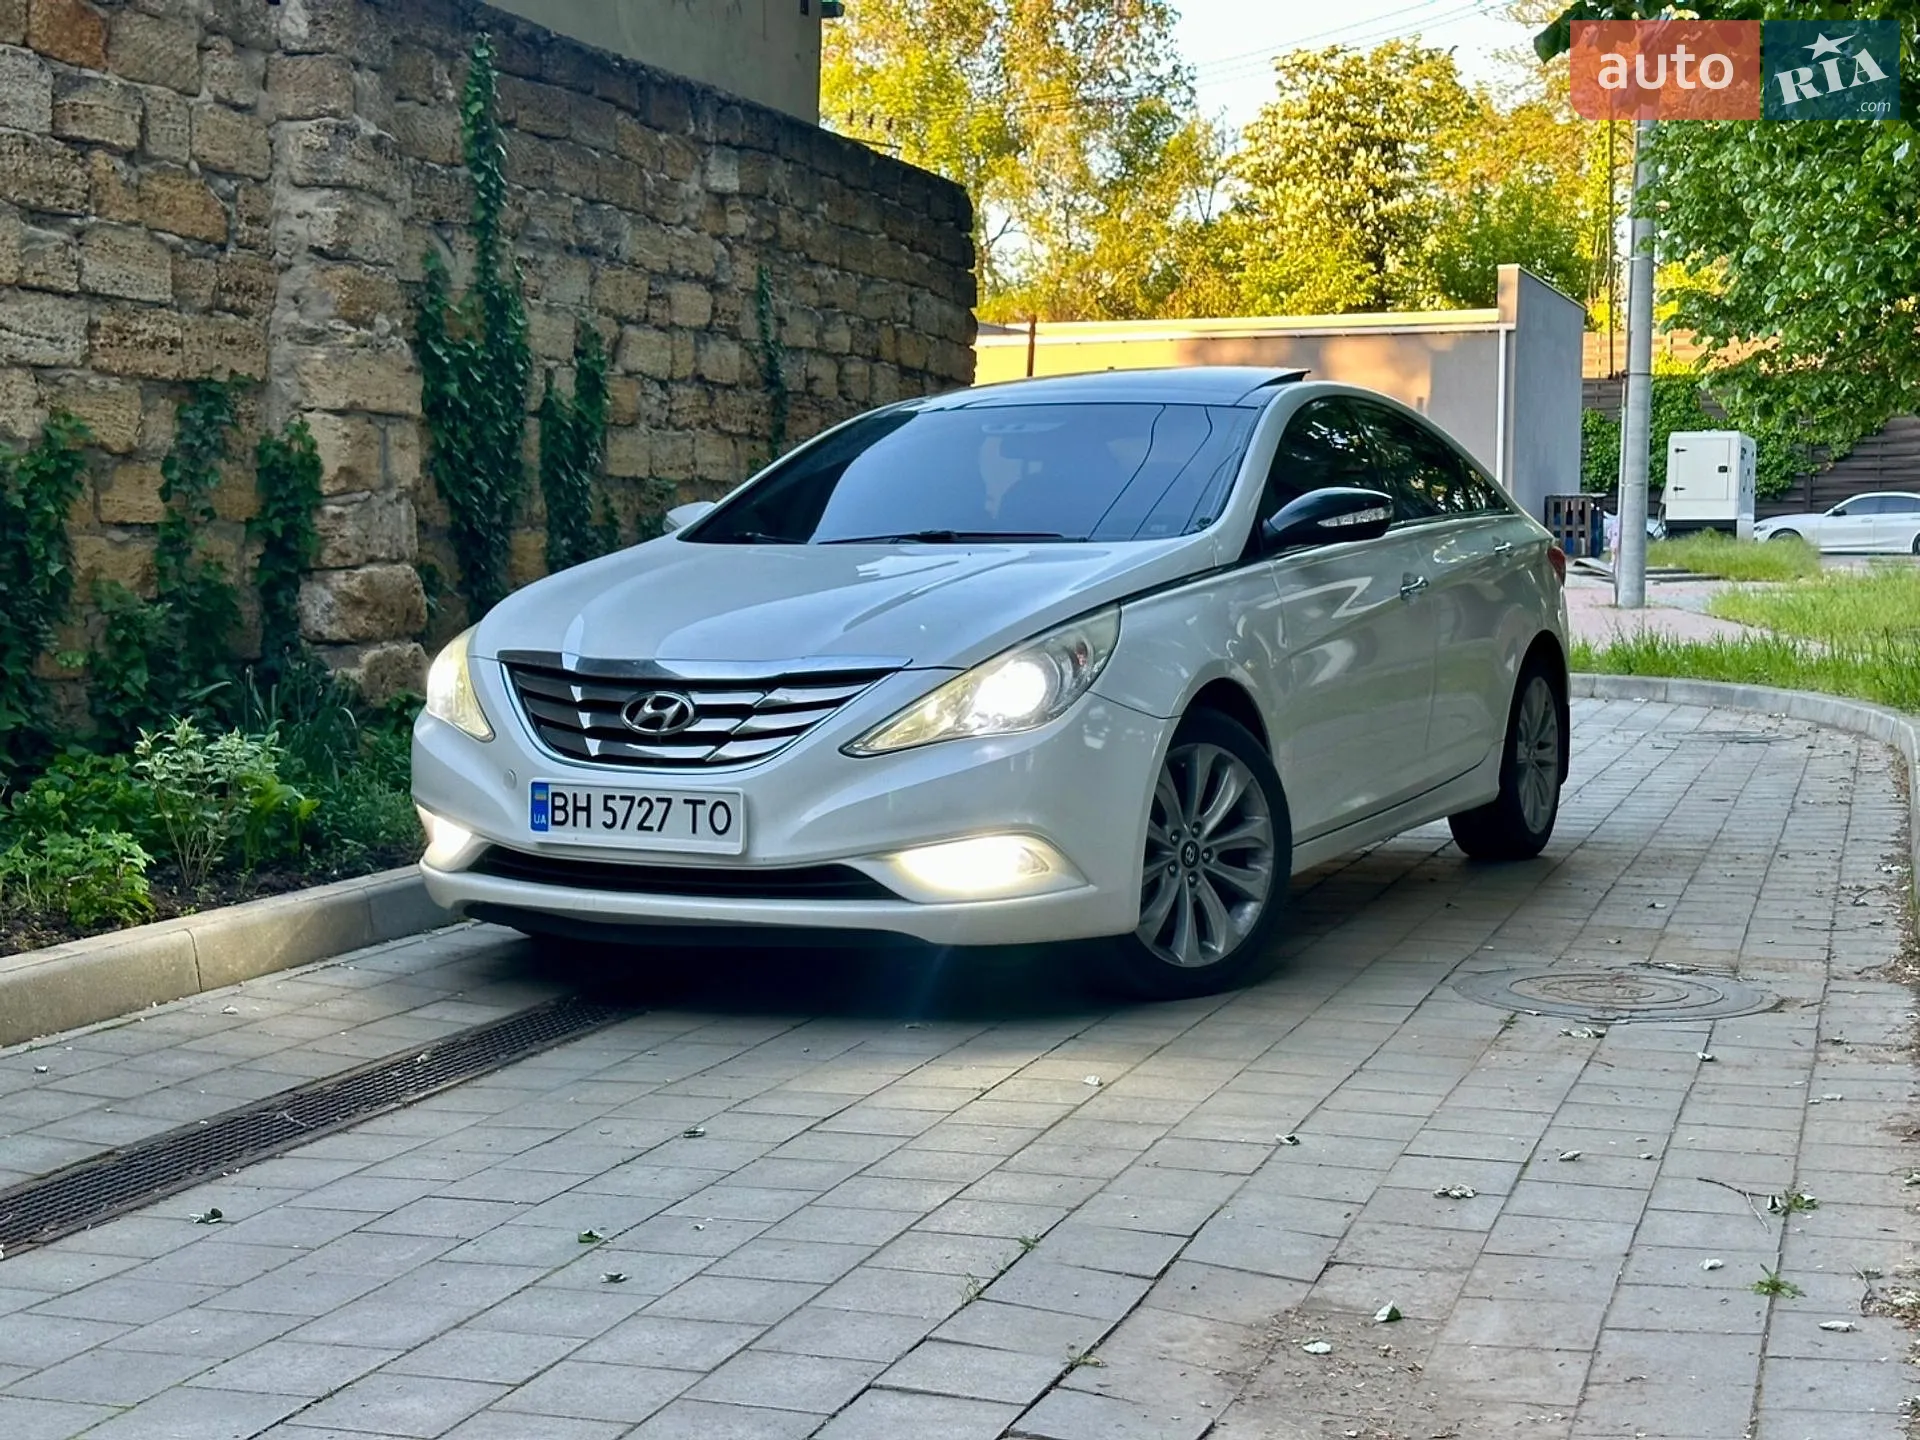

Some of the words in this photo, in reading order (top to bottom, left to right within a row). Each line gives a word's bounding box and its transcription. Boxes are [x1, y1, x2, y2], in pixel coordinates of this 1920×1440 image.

[533, 814, 547, 825] UA
[550, 791, 592, 828] BH
[602, 794, 673, 832] 5727
[683, 799, 732, 835] TO
